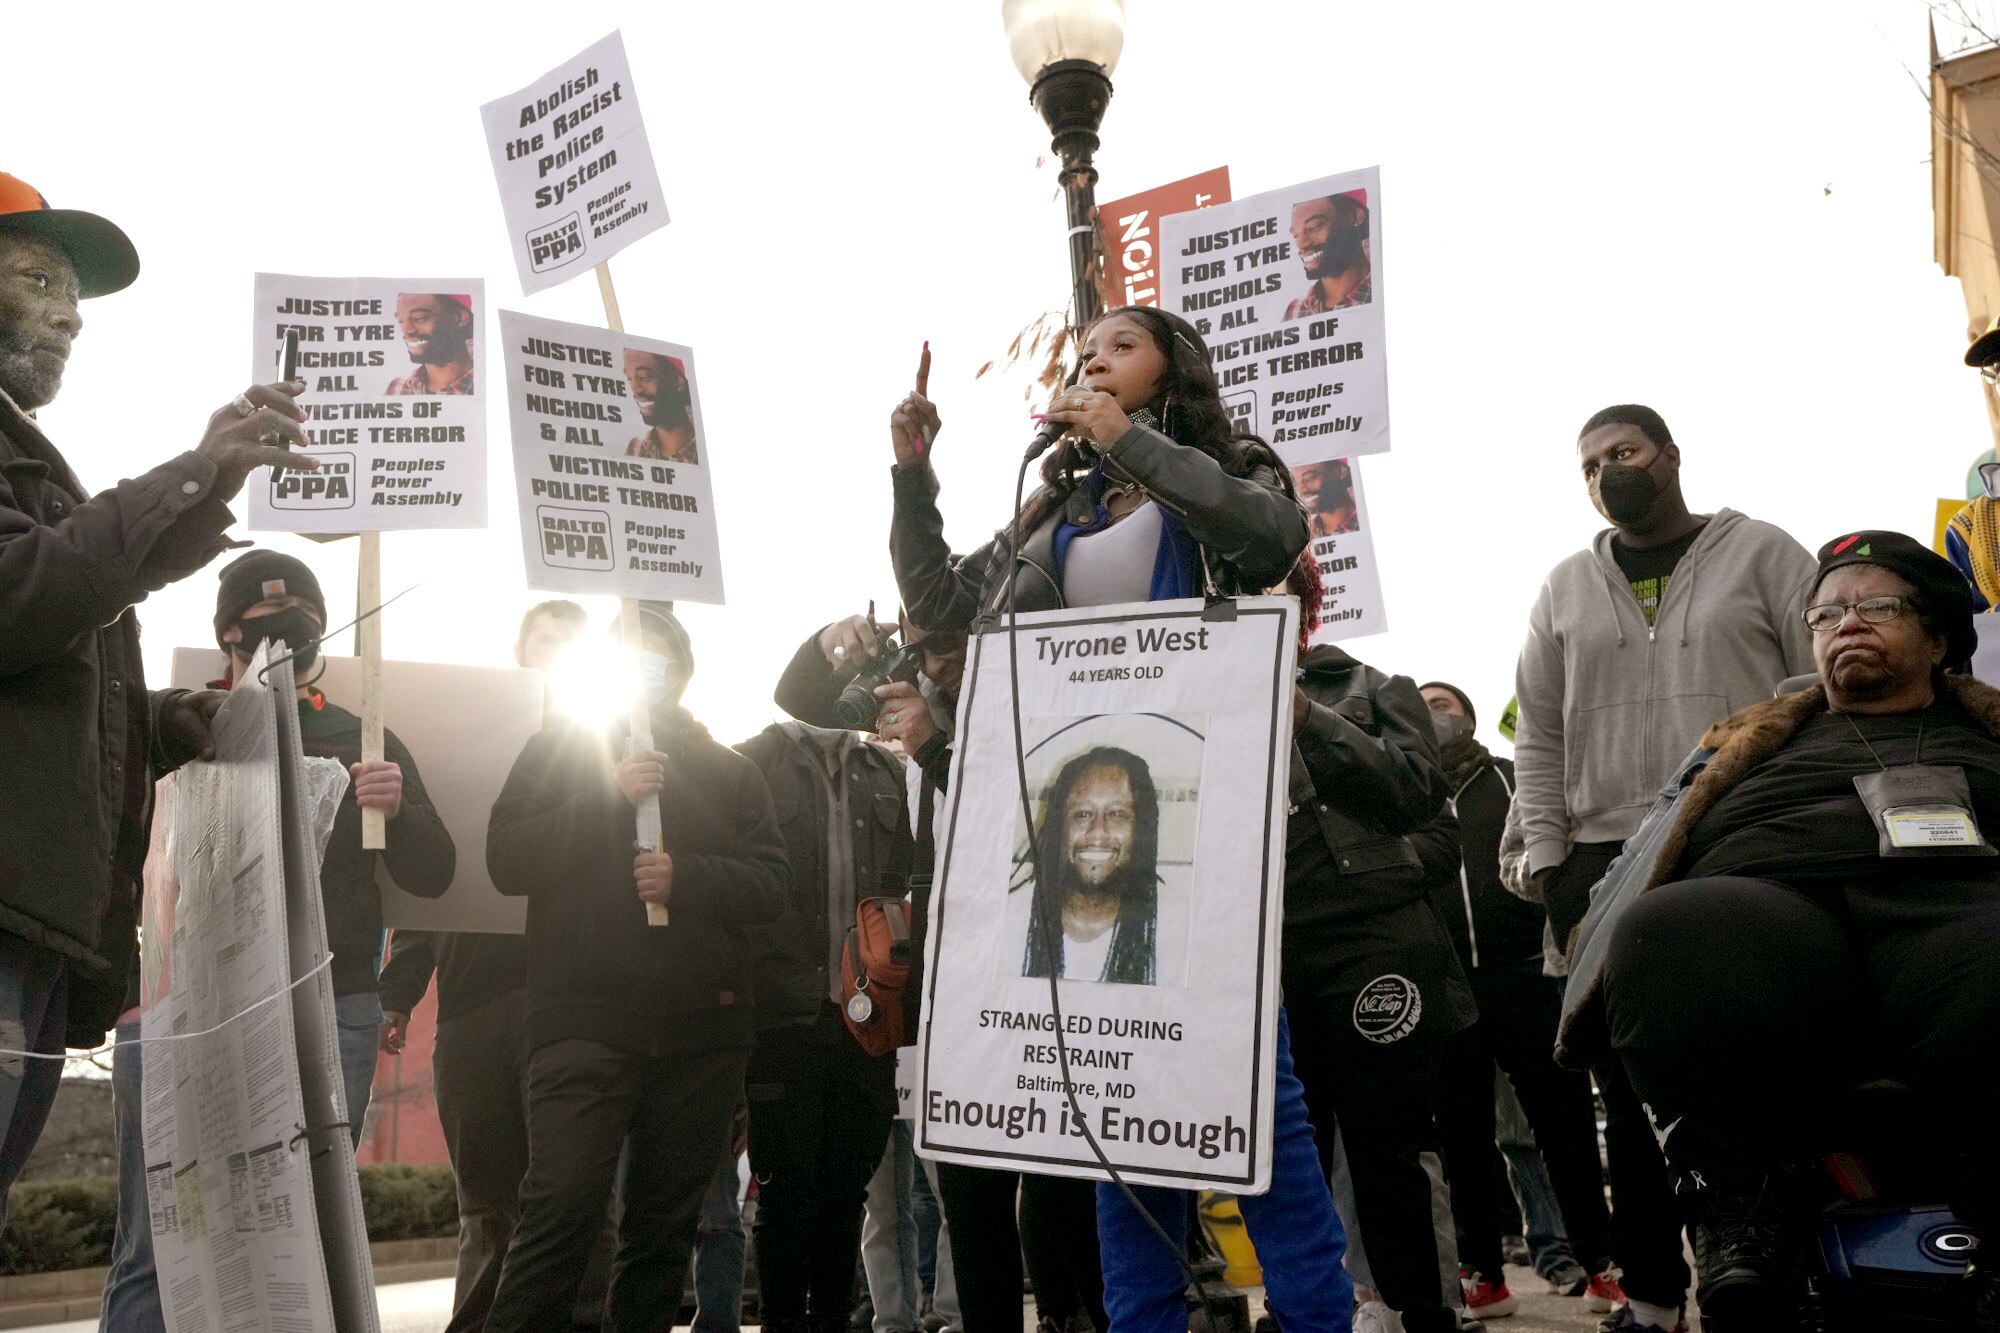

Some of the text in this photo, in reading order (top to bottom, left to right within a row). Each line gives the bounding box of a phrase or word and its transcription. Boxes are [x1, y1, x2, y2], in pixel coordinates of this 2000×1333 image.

[519, 67, 599, 129] Abolish
[505, 81, 622, 161] the Racist
[538, 125, 604, 179] Police
[535, 149, 617, 209] System
[587, 181, 632, 213] Peoples
[590, 198, 626, 226] Power
[593, 200, 648, 239] Assembly
[530, 220, 578, 248] BALTO
[1181, 216, 1278, 257] JUSTICE
[532, 231, 582, 265] PPA
[1181, 242, 1291, 285] FOR TYRE
[1182, 272, 1282, 313] NICHOLS
[276, 298, 382, 316] JUSTICE
[276, 324, 395, 342] FOR TYRE
[1195, 306, 1259, 336] & ALL
[1309, 318, 1339, 341] OF
[521, 337, 613, 368] JUSTICE
[1214, 341, 1364, 390] LICE TERROR
[316, 375, 359, 392] ALL
[523, 364, 627, 398] FOR TYRE
[1271, 382, 1344, 407] Peoples
[412, 401, 443, 419] OF
[526, 393, 623, 424] NICHOLS
[1272, 403, 1331, 425] Power
[305, 426, 466, 446] LICE TERROR
[540, 422, 604, 447] & ALL
[1273, 415, 1363, 444] Assembly
[371, 458, 446, 474] Peoples
[548, 454, 676, 485] VICTIMS OF
[276, 476, 349, 500] PPA
[371, 475, 433, 488] Power
[371, 491, 463, 507] Assembly
[531, 478, 698, 514] POLICE TERROR
[542, 516, 606, 534] BALTO
[624, 520, 685, 540] Peoples
[544, 531, 609, 561] PPA
[626, 538, 677, 556] Power
[1314, 540, 1337, 556] OF
[629, 556, 703, 578] Assembly
[1318, 556, 1358, 575] ROR
[1631, 577, 1658, 592] RAND
[1318, 608, 1363, 624] embly
[1035, 626, 1209, 666] Tyrone West
[1069, 666, 1163, 683] 44 YEARS OLD
[1378, 994, 1404, 1016] Cap
[1098, 1017, 1183, 1042] DURING
[1017, 1074, 1136, 1099] Baltimore, MD
[927, 1089, 1246, 1160] Enough is Enough
